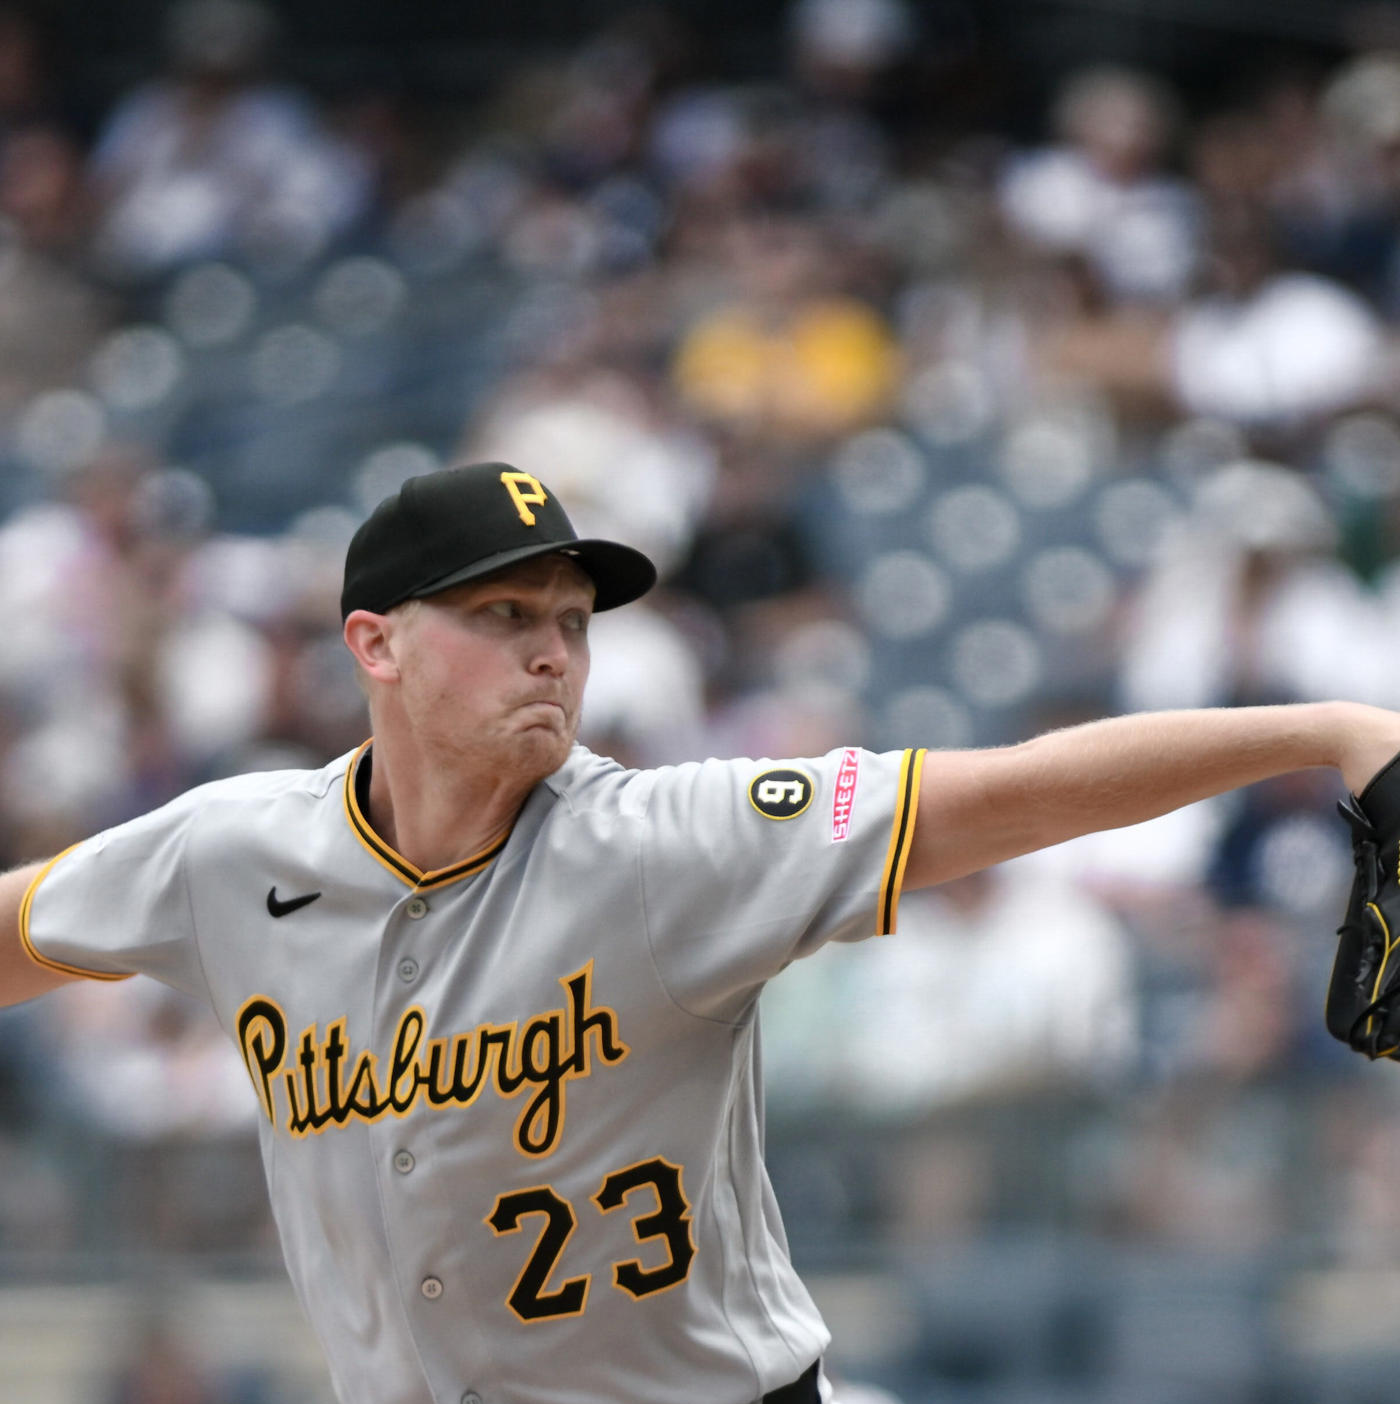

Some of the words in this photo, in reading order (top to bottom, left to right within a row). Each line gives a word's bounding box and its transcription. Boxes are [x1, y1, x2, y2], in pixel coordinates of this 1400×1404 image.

[500, 471, 548, 526] P
[832, 751, 860, 840] SHEETZ
[235, 957, 632, 1159] Pittsburgh
[482, 1154, 699, 1324] 23
